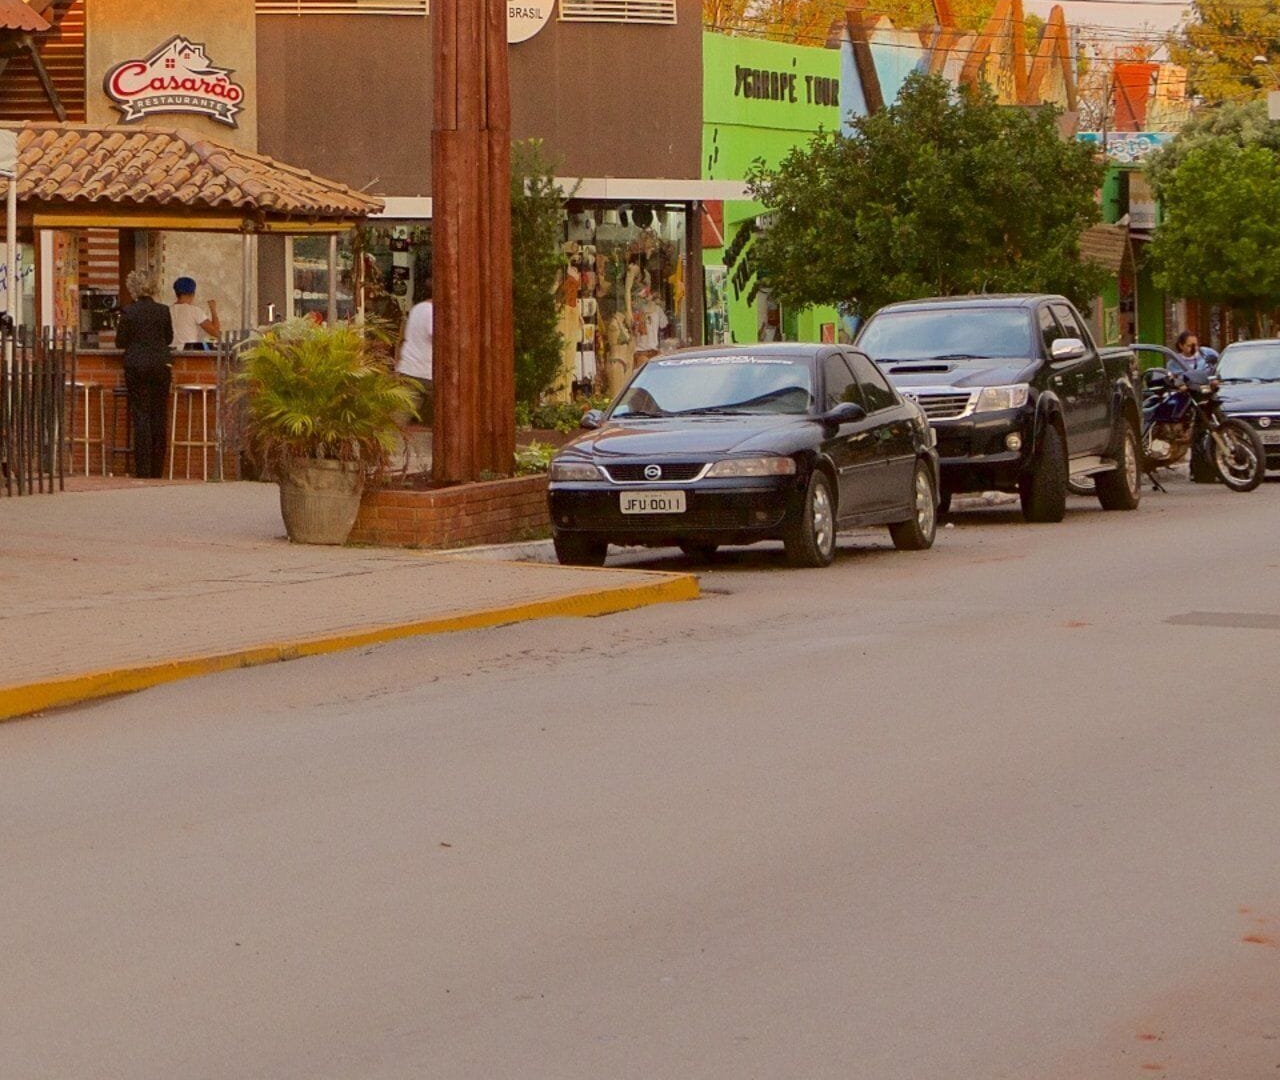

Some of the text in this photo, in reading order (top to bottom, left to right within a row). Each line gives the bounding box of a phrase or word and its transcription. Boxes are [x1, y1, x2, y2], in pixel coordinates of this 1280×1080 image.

[508, 7, 544, 20] BRASIL
[112, 62, 240, 102] Casarão
[136, 96, 224, 111] RESTAURANTE
[624, 498, 680, 511] JFU 0011
